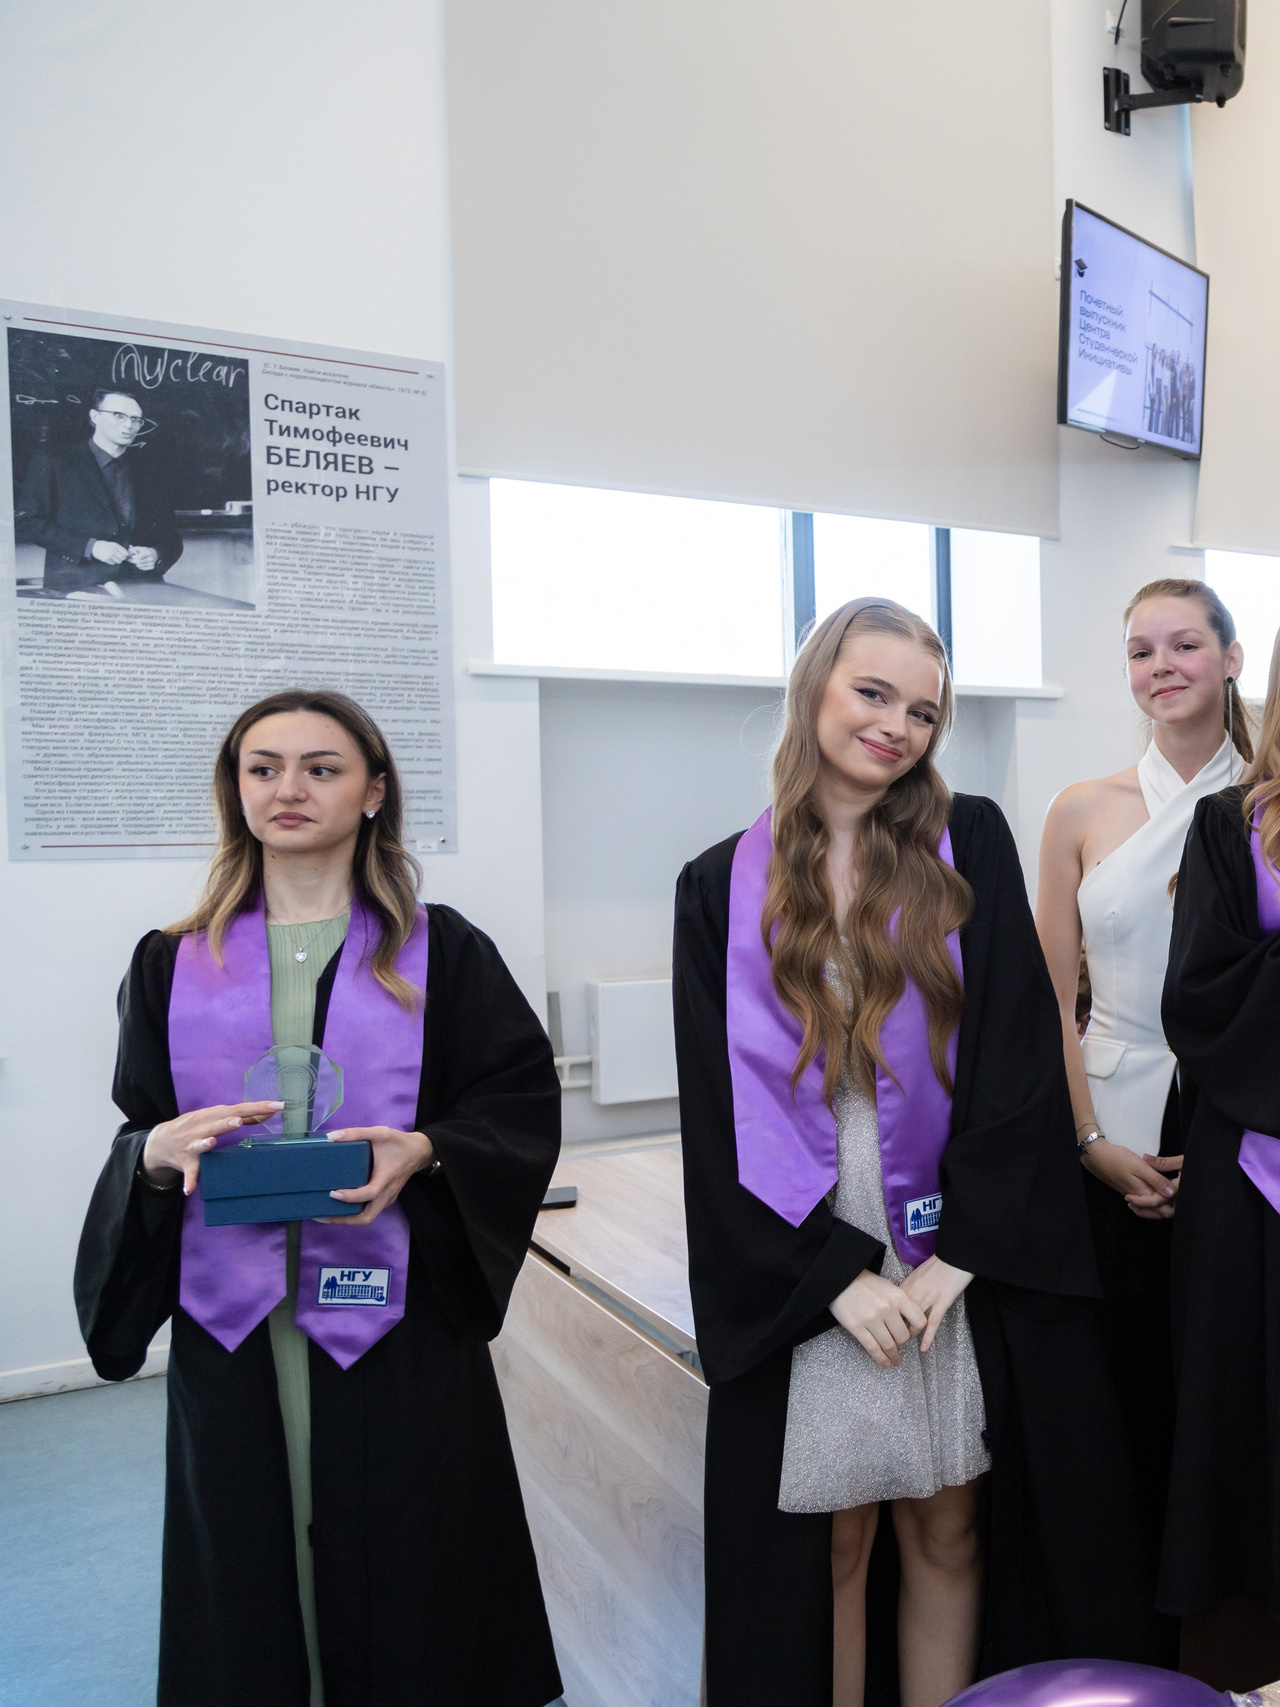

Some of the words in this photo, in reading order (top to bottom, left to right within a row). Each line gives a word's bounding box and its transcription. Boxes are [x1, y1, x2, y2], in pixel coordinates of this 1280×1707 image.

[1080, 289, 1123, 317] Почетный
[1079, 318, 1111, 340] Центра
[1080, 306, 1127, 333] выпускник
[1079, 333, 1139, 364] Студенческой
[1078, 346, 1133, 376] Инициативы
[262, 369, 284, 377] Беседа
[289, 373, 342, 385] корреспондентом
[343, 380, 367, 388] журнала
[264, 393, 361, 421] Спартак
[264, 418, 409, 451] Тимофеевич
[266, 445, 374, 475] БЕЛЯЕВ
[267, 478, 348, 502] ректор
[355, 484, 400, 503] НГУ
[88, 604, 131, 613] удивлением
[45, 652, 90, 660] индикаторы
[91, 654, 135, 662] творческого
[64, 660, 114, 668] университете
[41, 665, 81, 673] половиной
[34, 779, 75, 788] Атмосфера
[34, 786, 56, 794] Когда
[922, 1197, 942, 1212] НГ
[340, 1270, 373, 1282] НГУ
